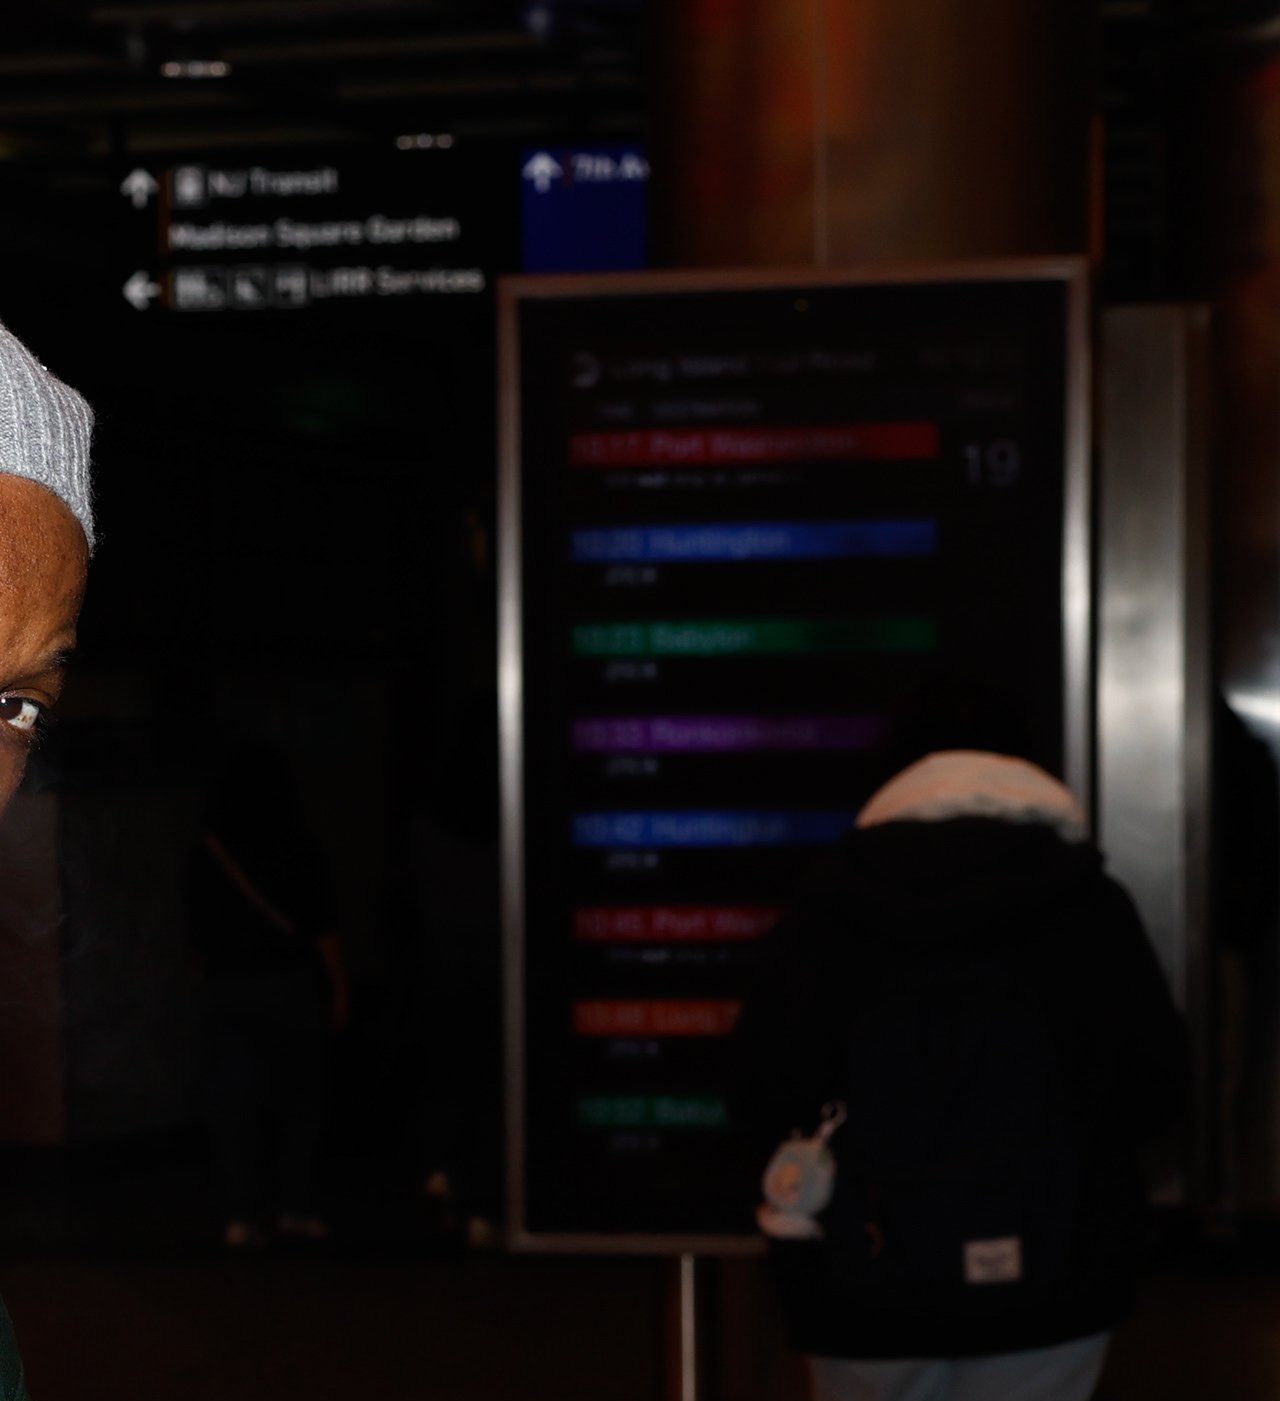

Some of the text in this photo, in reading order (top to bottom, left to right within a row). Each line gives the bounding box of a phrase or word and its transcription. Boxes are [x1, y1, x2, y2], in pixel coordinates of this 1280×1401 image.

[250, 164, 339, 195] Transit
[168, 213, 462, 252] Madison Square Garden
[375, 265, 486, 294] Services
[960, 438, 1021, 488] 19
